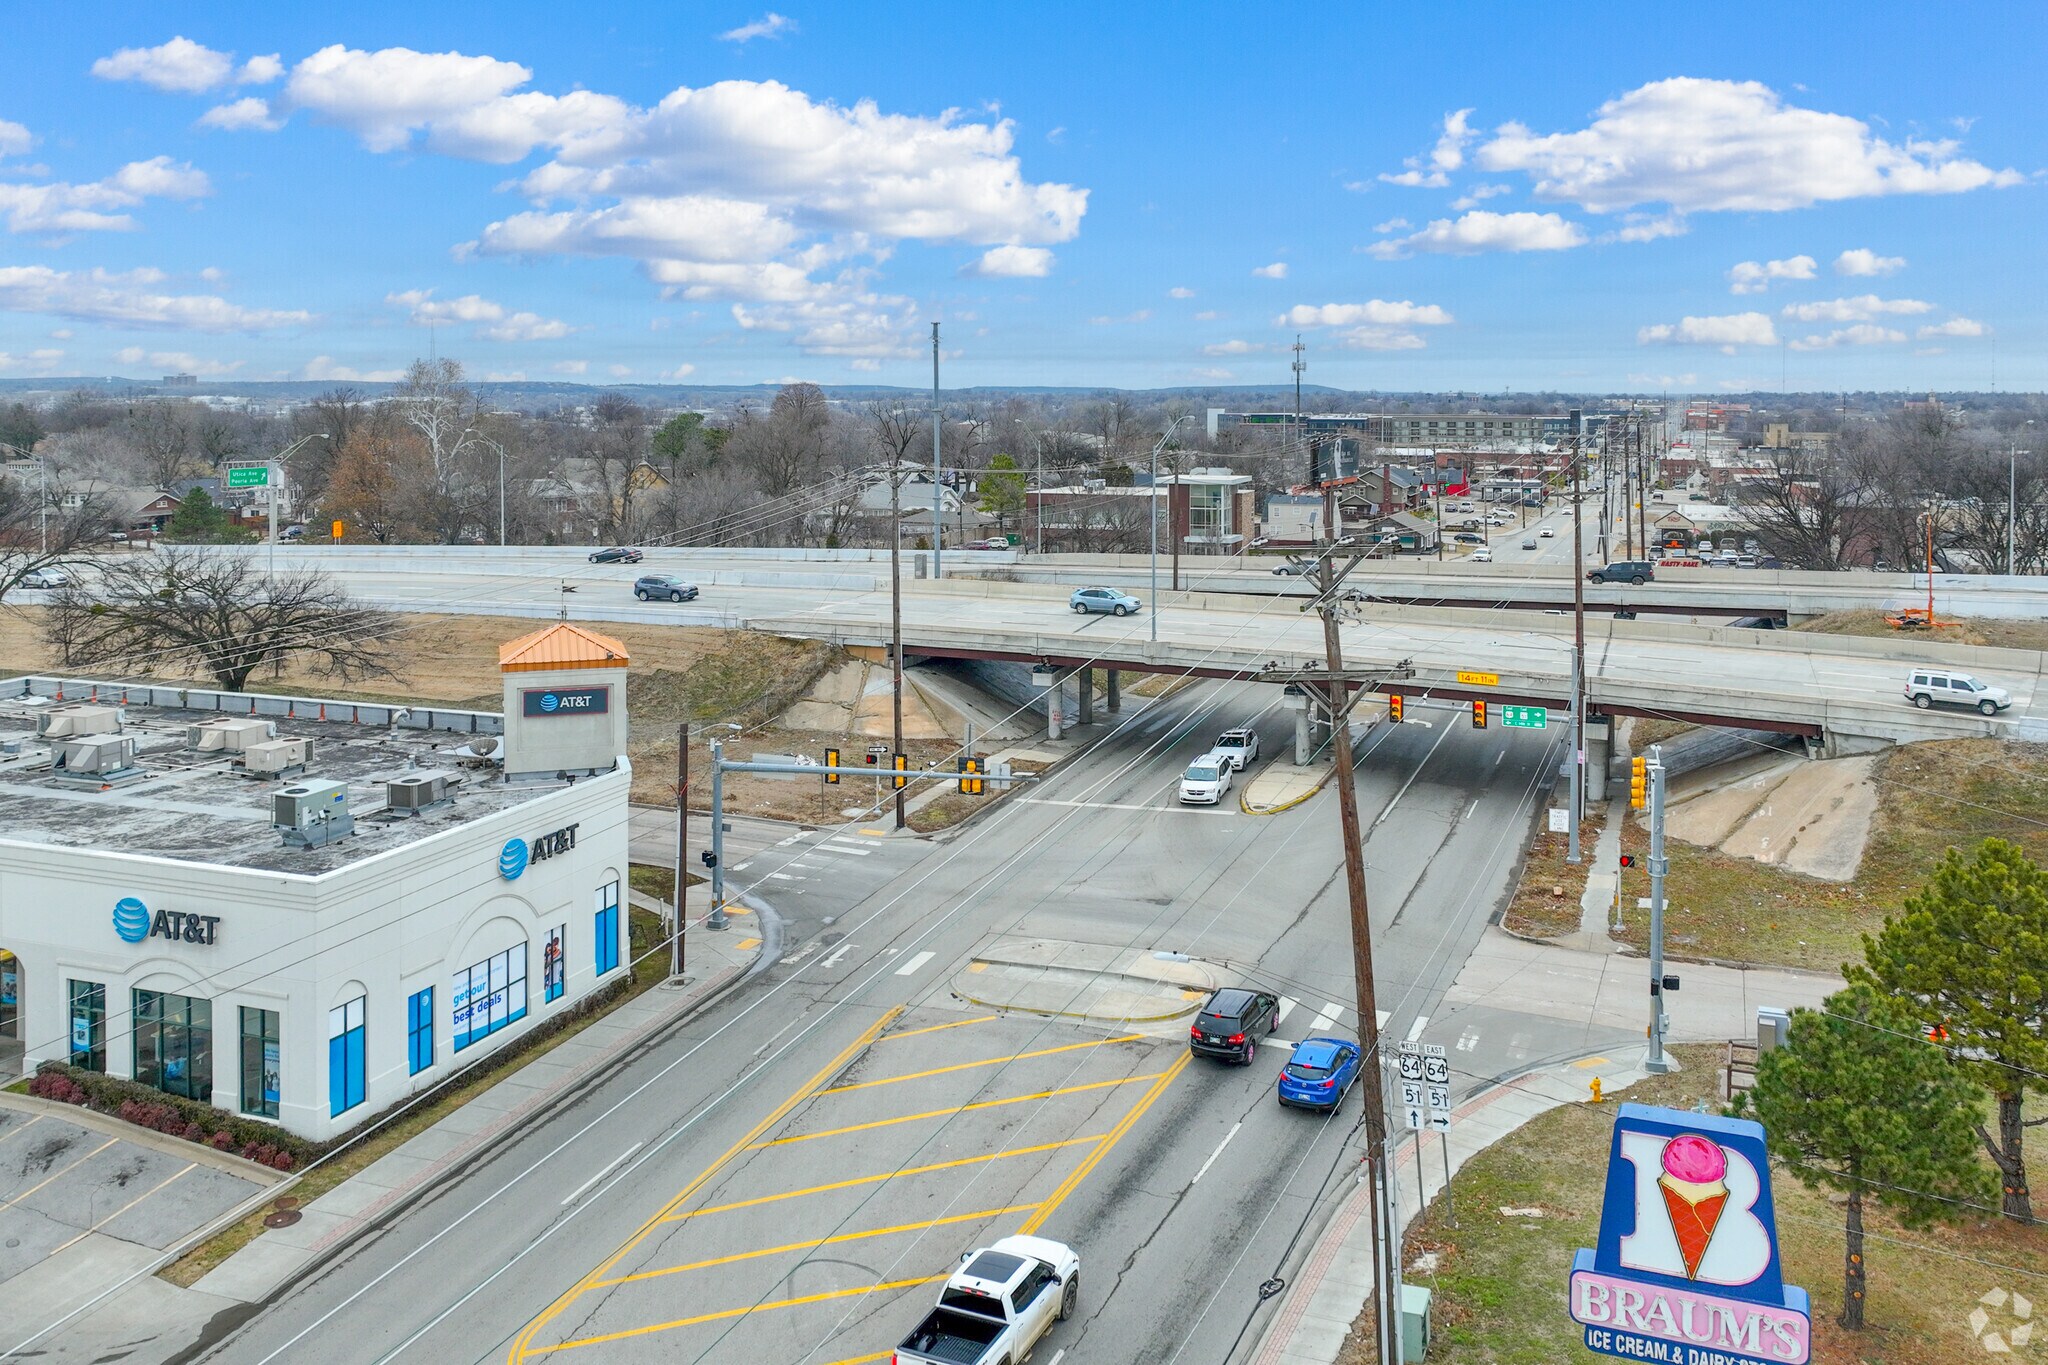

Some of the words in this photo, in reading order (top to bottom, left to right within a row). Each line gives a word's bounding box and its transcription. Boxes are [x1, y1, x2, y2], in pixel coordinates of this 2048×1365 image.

[560, 695, 592, 708] AT&T
[531, 823, 579, 865] AT&T
[150, 909, 220, 945] AT&T
[453, 989, 470, 1007] get
[471, 982, 486, 996] our
[453, 1006, 474, 1025] best
[477, 993, 502, 1013] deals
[1401, 1043, 1417, 1051] WEST
[1427, 1046, 1442, 1054] EAST
[1402, 1057, 1419, 1074] 64
[1428, 1063, 1446, 1077] 64
[1405, 1088, 1420, 1104] 51
[1431, 1092, 1447, 1107] 51
[1577, 1280, 1802, 1360] BRAUM'S
[1588, 1329, 1611, 1350] ICE
[1615, 1334, 1668, 1361] CREAM
[1672, 1346, 1684, 1365] &
